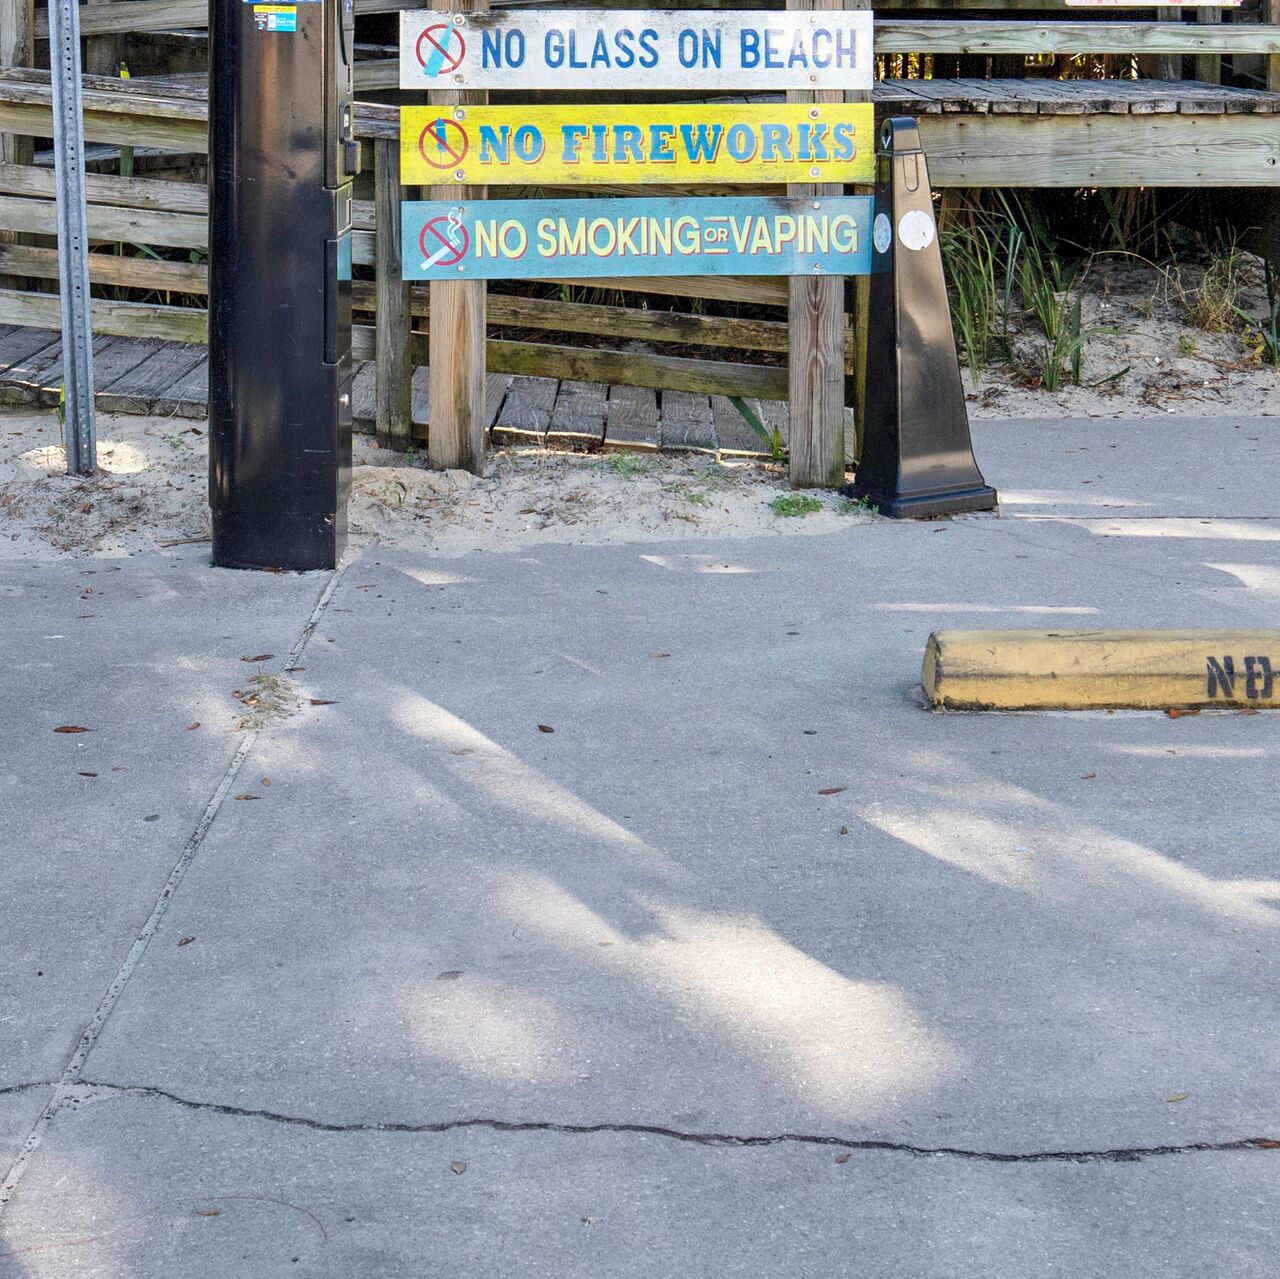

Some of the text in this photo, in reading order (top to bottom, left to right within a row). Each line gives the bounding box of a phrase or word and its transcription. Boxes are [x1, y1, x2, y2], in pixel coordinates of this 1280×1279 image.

[482, 28, 856, 69] NO GLASS ON BEACH
[479, 123, 857, 163] NO FIREWORKS
[475, 215, 858, 258] NO SMOKING OR VAPING
[1206, 655, 1274, 699] NO
